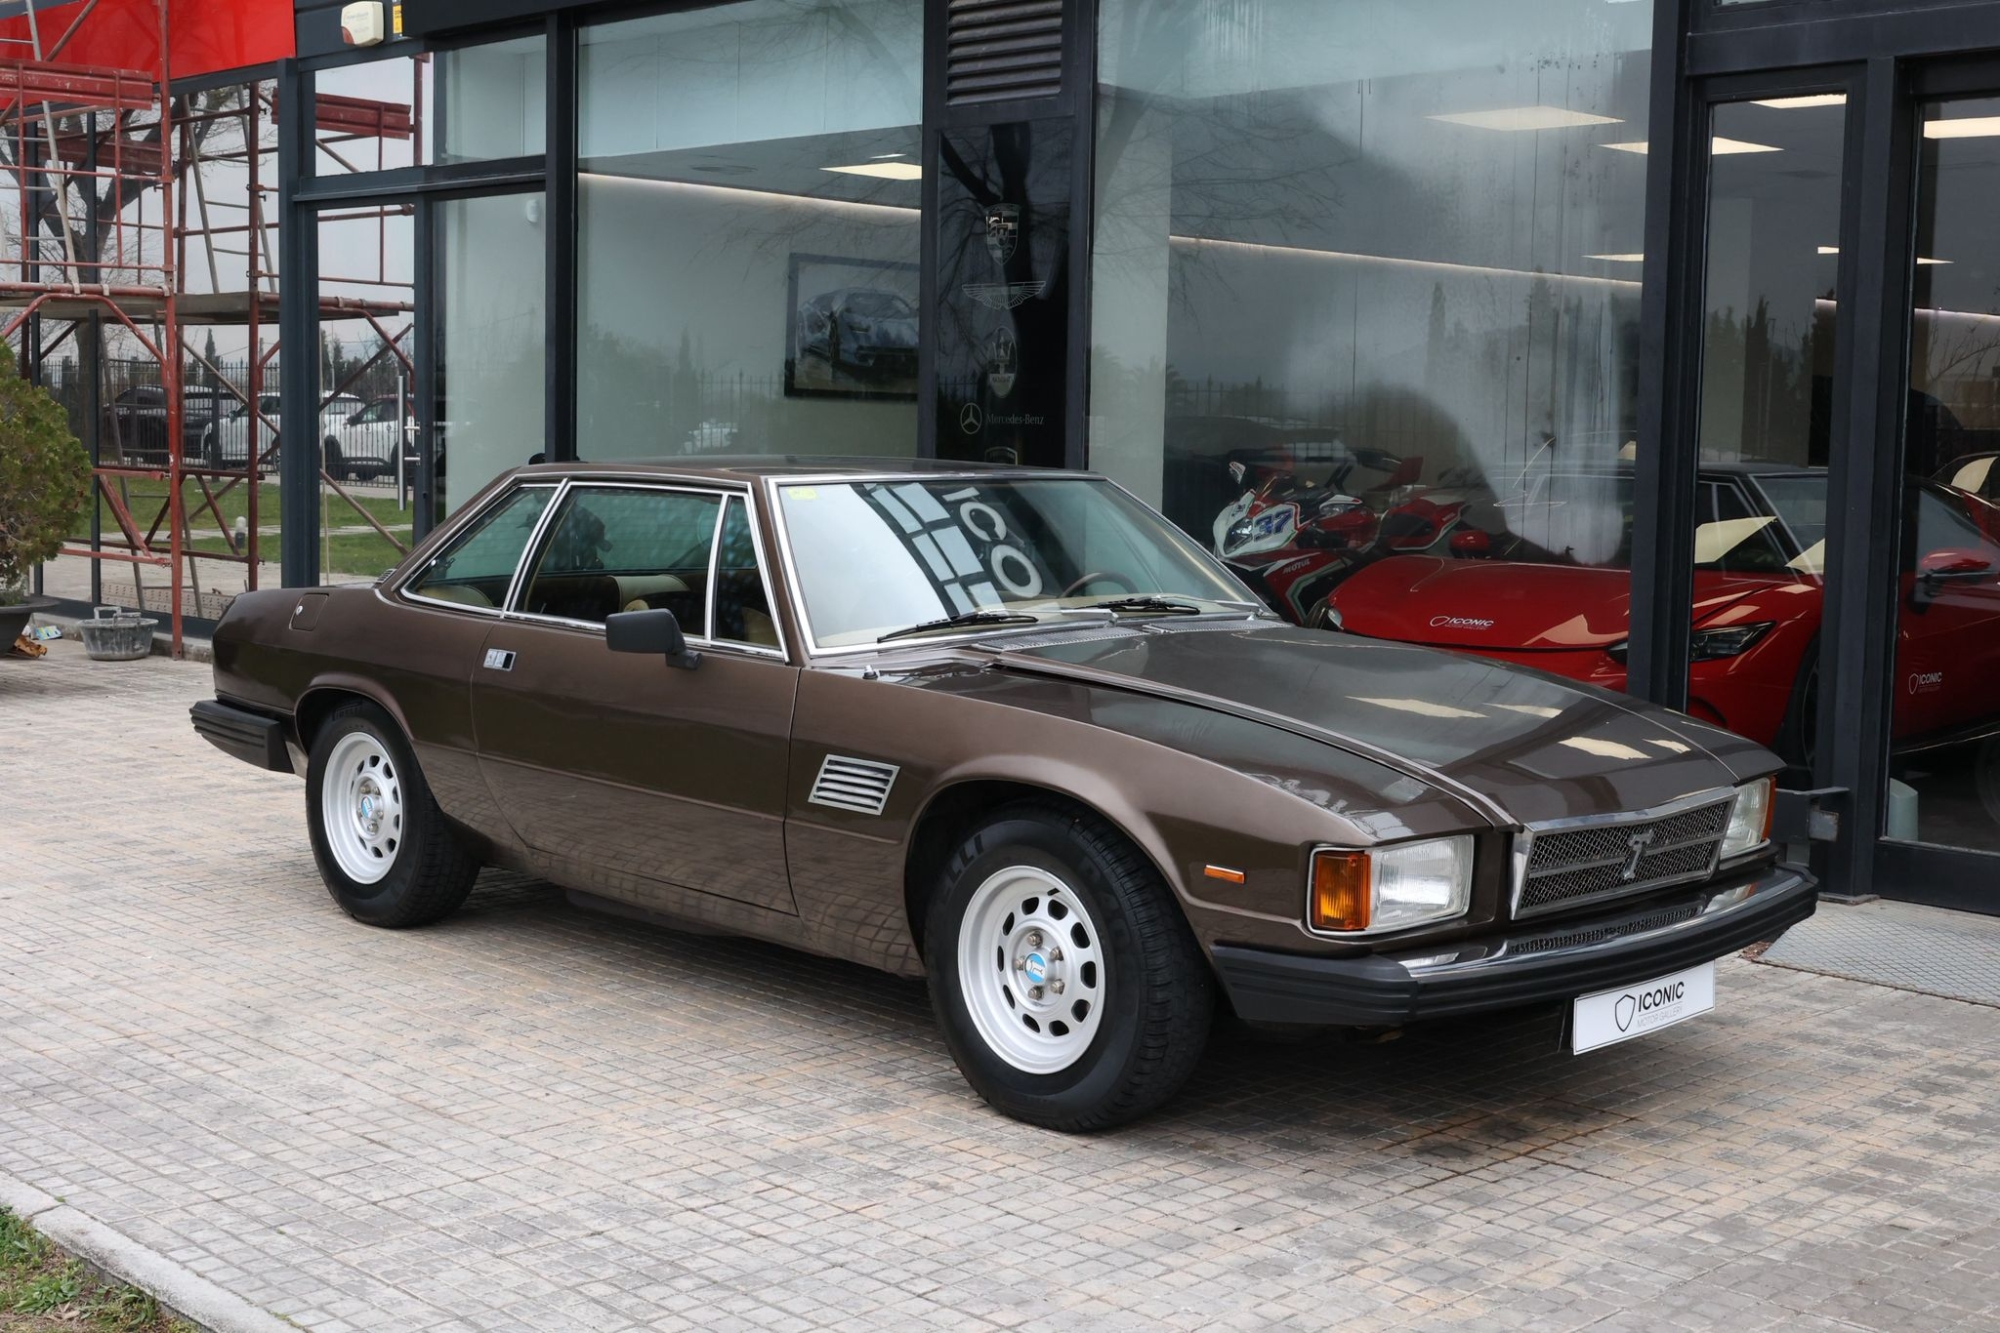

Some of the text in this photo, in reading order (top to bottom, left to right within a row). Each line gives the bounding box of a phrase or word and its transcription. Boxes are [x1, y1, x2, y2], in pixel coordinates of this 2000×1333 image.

[986, 413, 1044, 425] Mercedes-Benz
[1254, 508, 1293, 542] 37
[1283, 559, 1310, 574] MOTUL
[1448, 617, 1494, 627] ICONIC
[1919, 671, 1942, 685] ICONIC
[1638, 981, 1684, 1012] ICONIC
[1637, 1013, 1659, 1027] MOTOR
